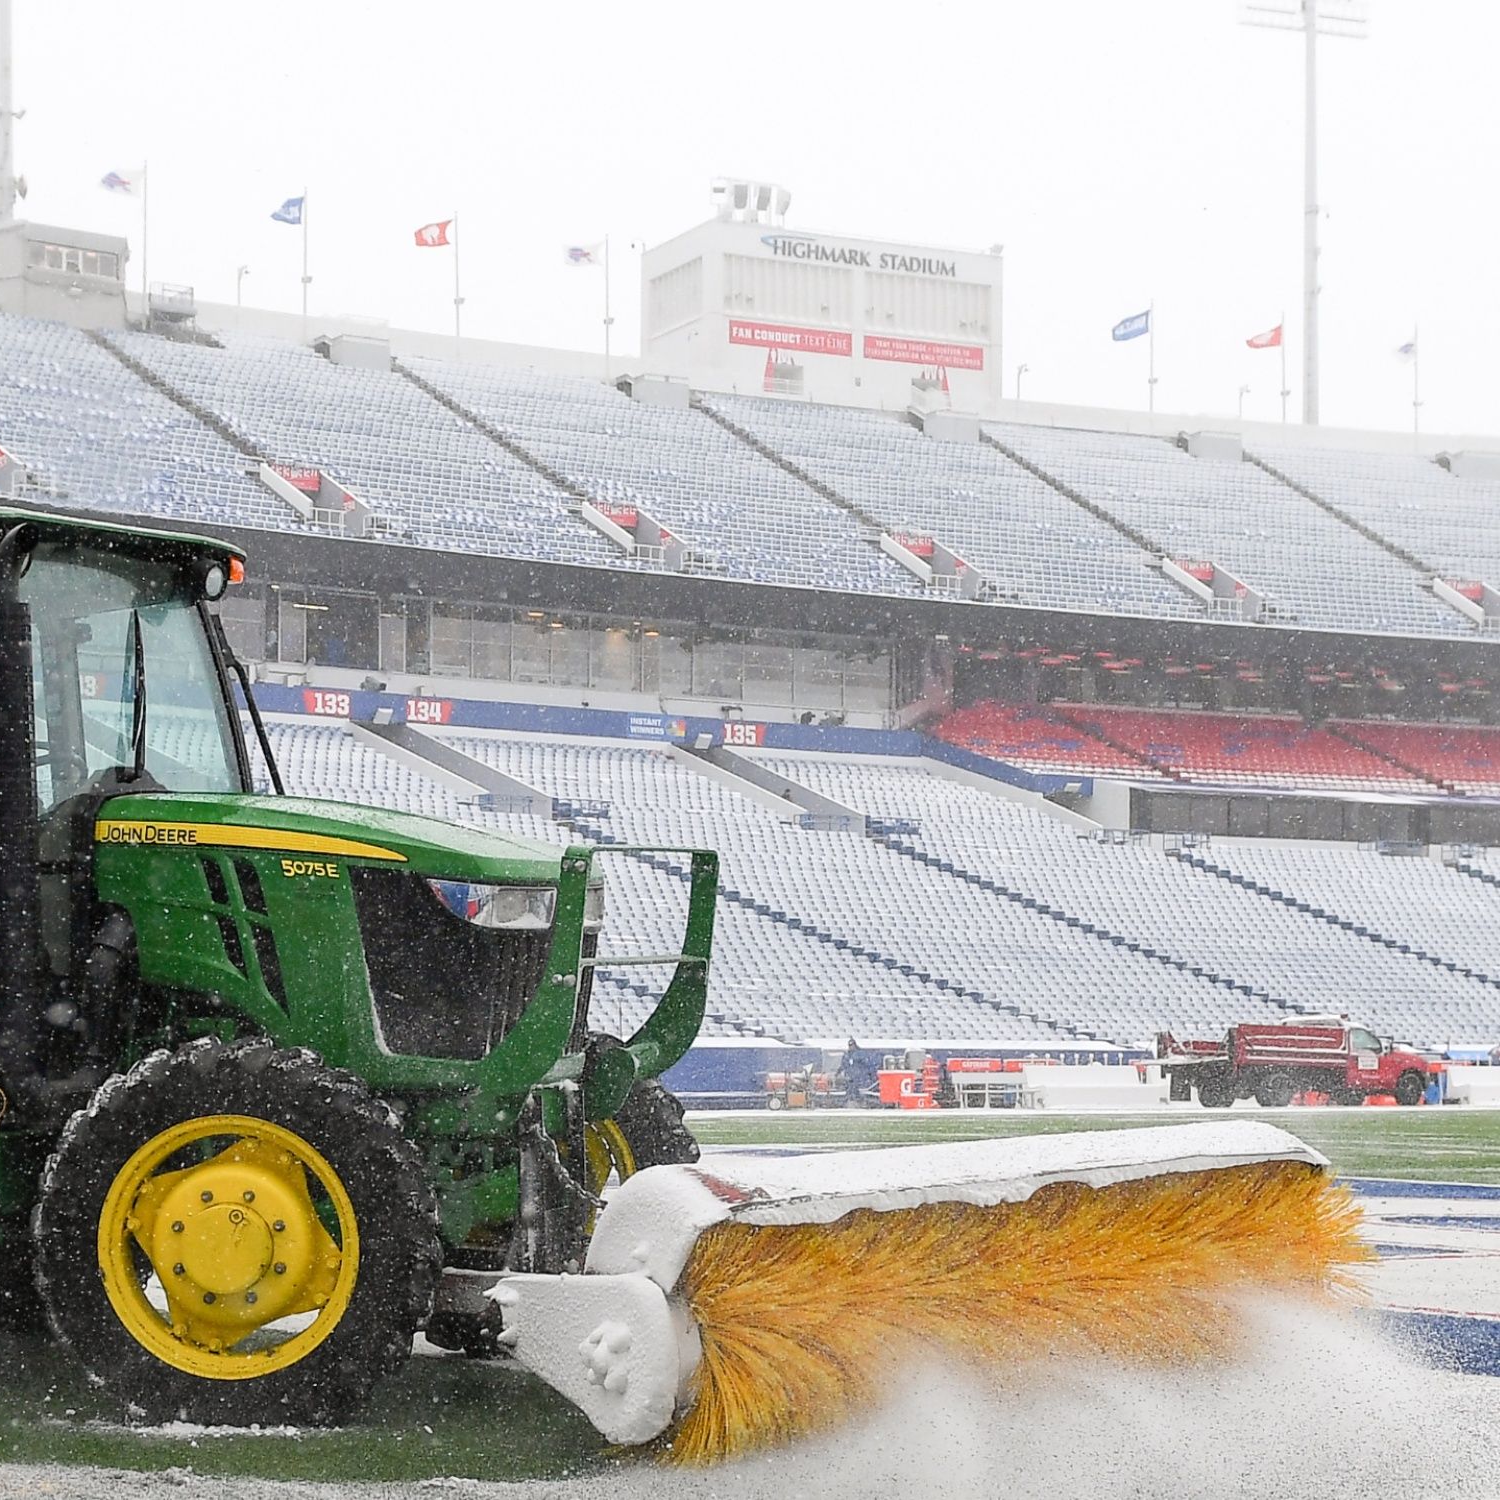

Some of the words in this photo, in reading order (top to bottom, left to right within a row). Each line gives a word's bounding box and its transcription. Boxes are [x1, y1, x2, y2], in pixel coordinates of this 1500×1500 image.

[773, 239, 871, 267] HIGHMARK
[879, 253, 956, 277] STADIUM
[732, 326, 752, 338] FAN
[754, 329, 801, 344] CONDUCT
[314, 692, 350, 715] 133
[407, 700, 441, 722] 134
[630, 716, 662, 727] INSTANT
[630, 725, 665, 736] WINNERS
[724, 723, 757, 744] 135
[102, 825, 144, 843] JOHN
[144, 825, 198, 844] DEERE
[901, 1078, 912, 1095] G
